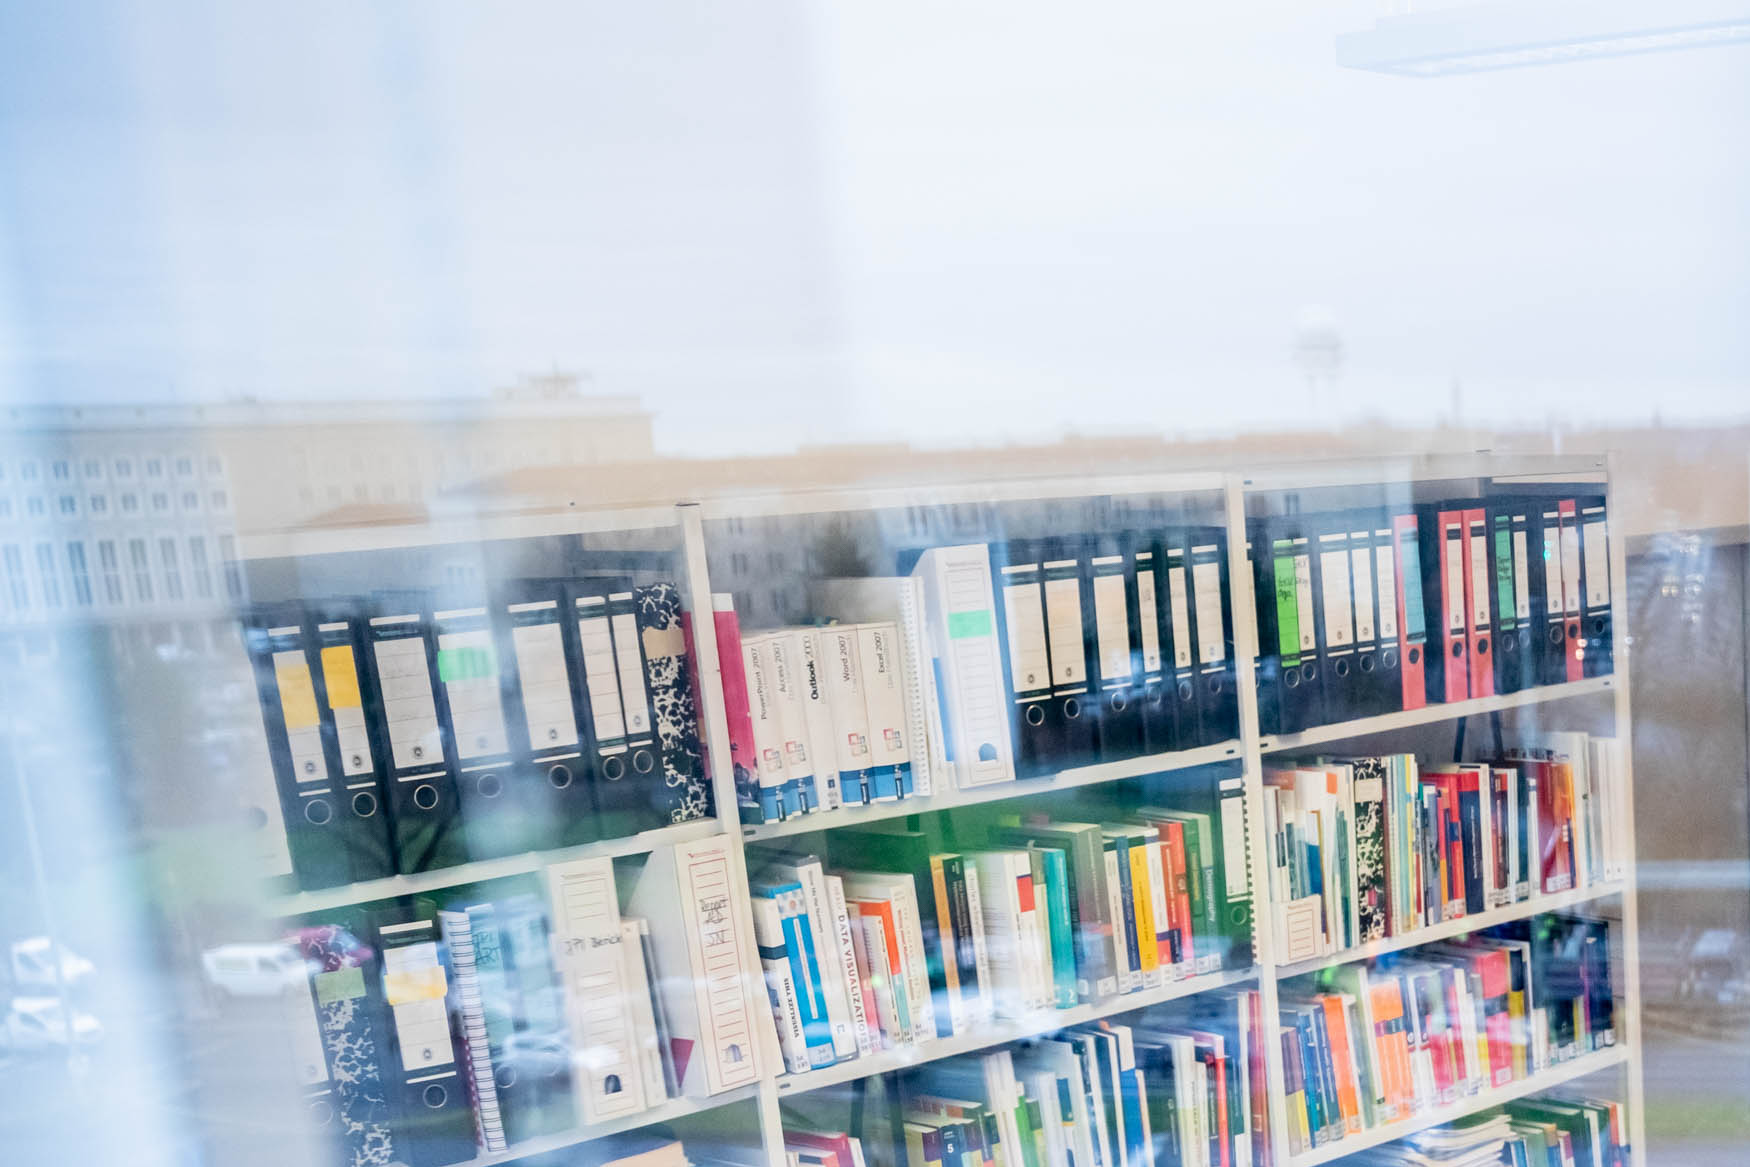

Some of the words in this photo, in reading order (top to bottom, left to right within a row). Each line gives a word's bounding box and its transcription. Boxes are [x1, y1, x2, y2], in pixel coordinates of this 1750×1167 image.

[837, 635, 849, 661] 2007
[873, 631, 883, 652] 2007
[750, 647, 761, 669] 2007
[877, 653, 886, 674] Excel
[777, 664, 787, 693] Access
[806, 659, 819, 700] Outlook
[842, 661, 851, 682] Word
[754, 668, 768, 721] PowerPoint
[838, 914, 849, 946] DATA
[844, 950, 867, 1037] VISUALIZATIO
[947, 1143, 955, 1154] 5
